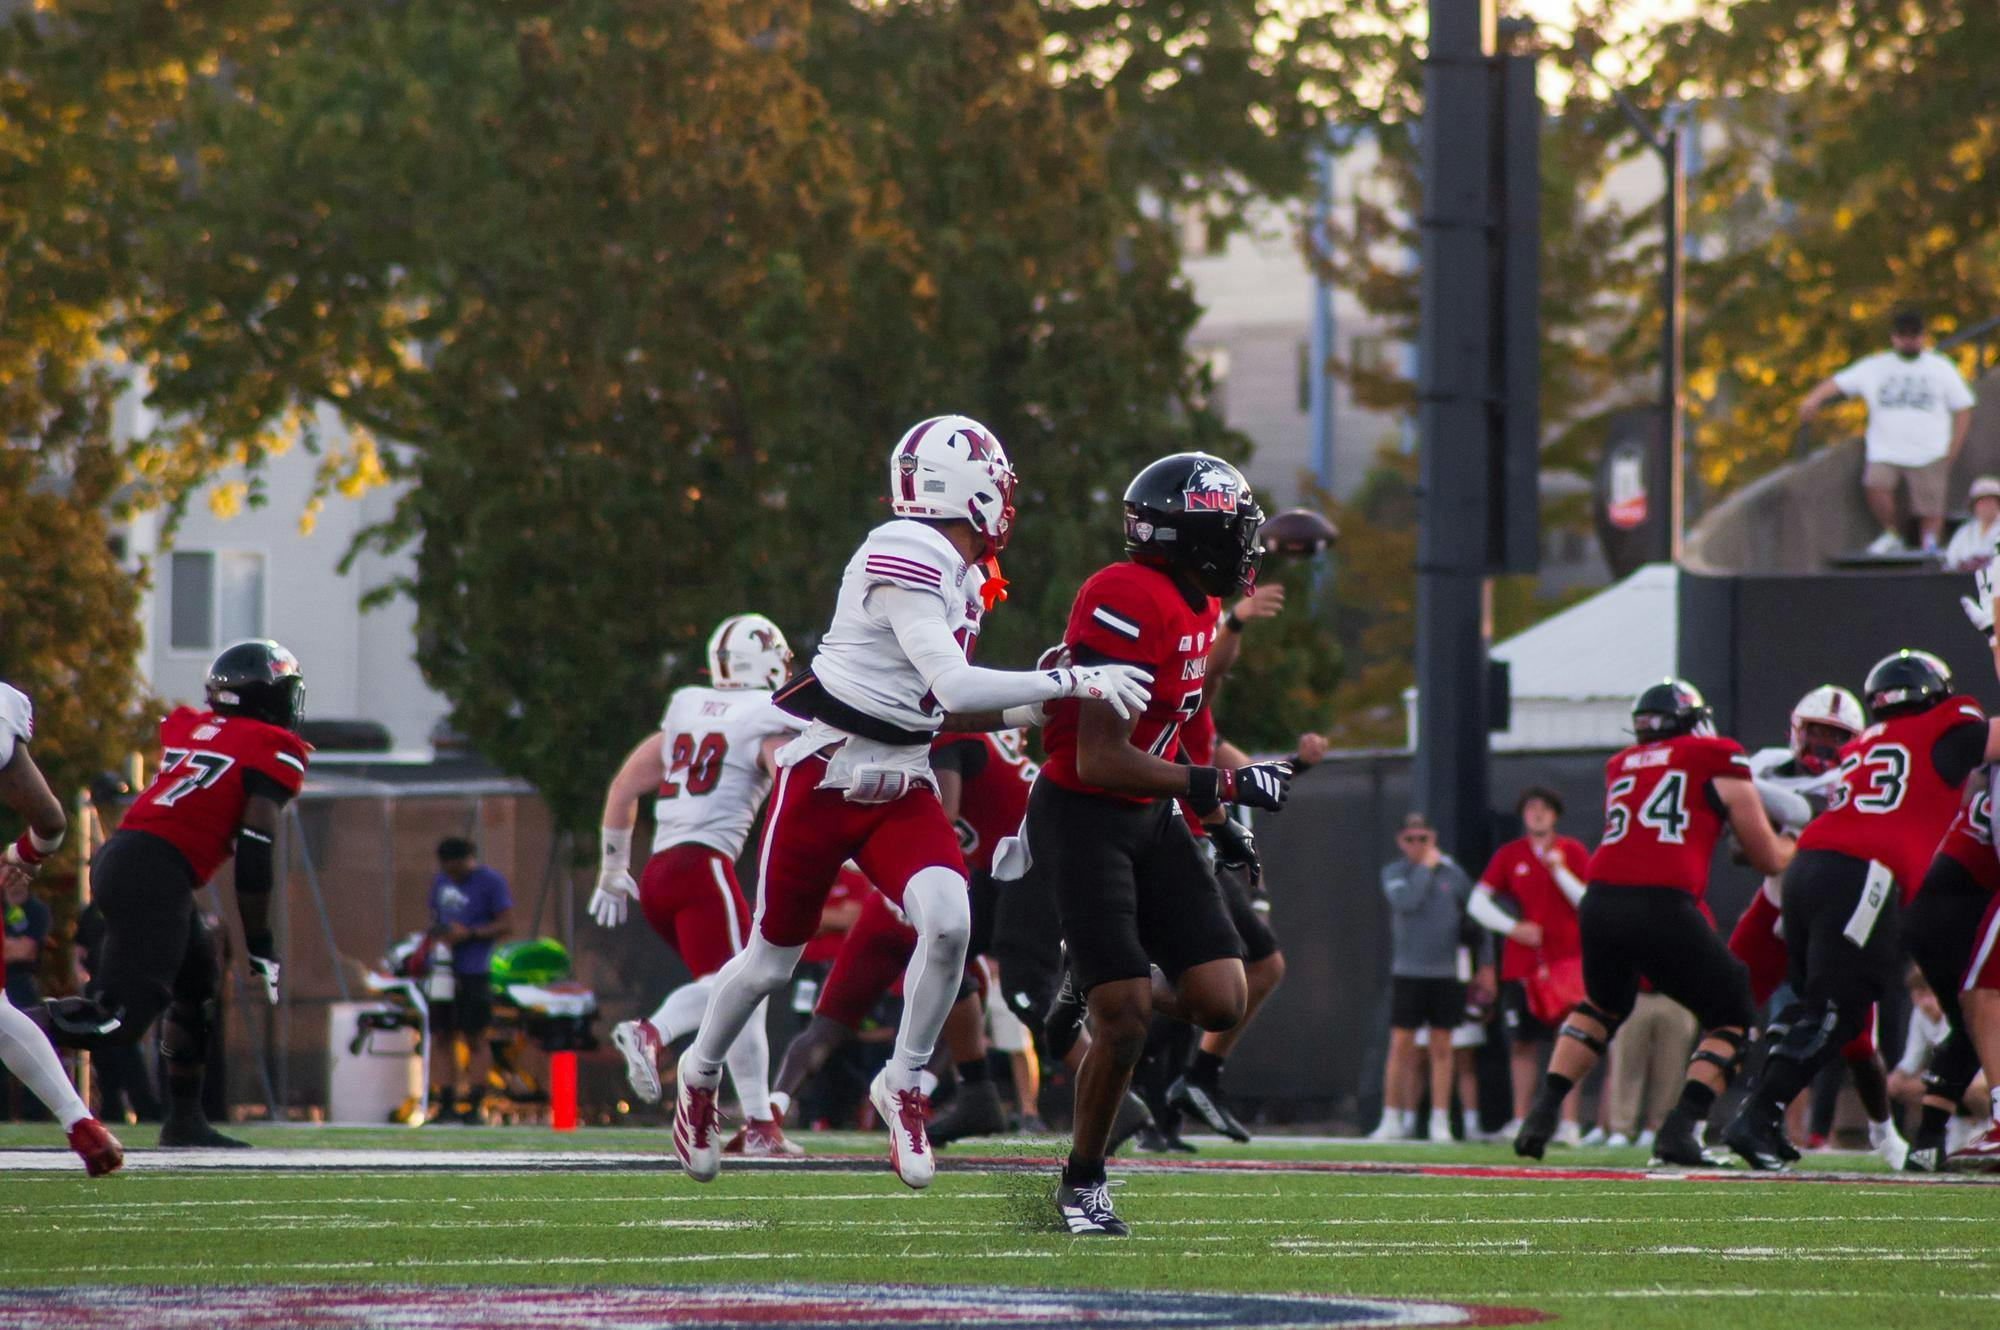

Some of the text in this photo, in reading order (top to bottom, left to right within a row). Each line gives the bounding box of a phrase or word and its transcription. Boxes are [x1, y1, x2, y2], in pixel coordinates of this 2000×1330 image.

[1188, 491, 1235, 510] NIU
[1181, 655, 1208, 680] NIU
[153, 747, 236, 807] 77
[657, 732, 728, 799] 20
[1601, 769, 1691, 845] 54
